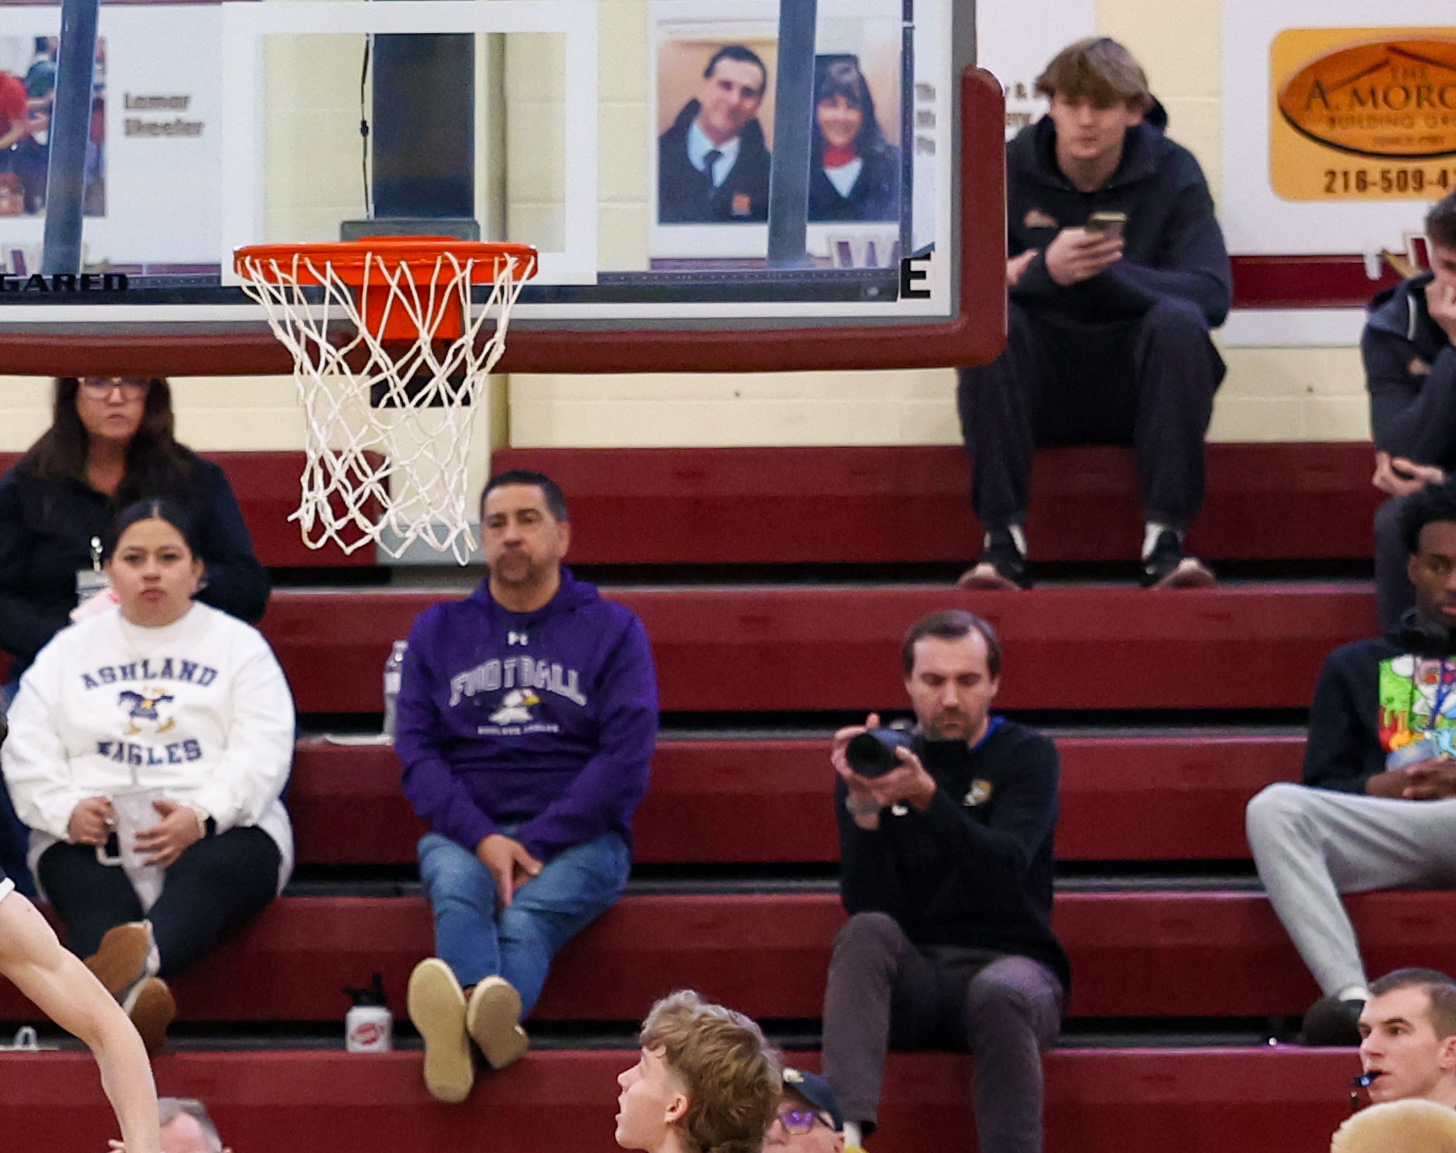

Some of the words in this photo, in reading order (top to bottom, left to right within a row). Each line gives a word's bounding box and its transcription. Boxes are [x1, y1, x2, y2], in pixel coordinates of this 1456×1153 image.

[1323, 168, 1456, 193] 216-509-4
[81, 657, 219, 690] ASHLAND
[448, 655, 588, 708] FOOTBALL
[97, 738, 204, 766] EAGLES
